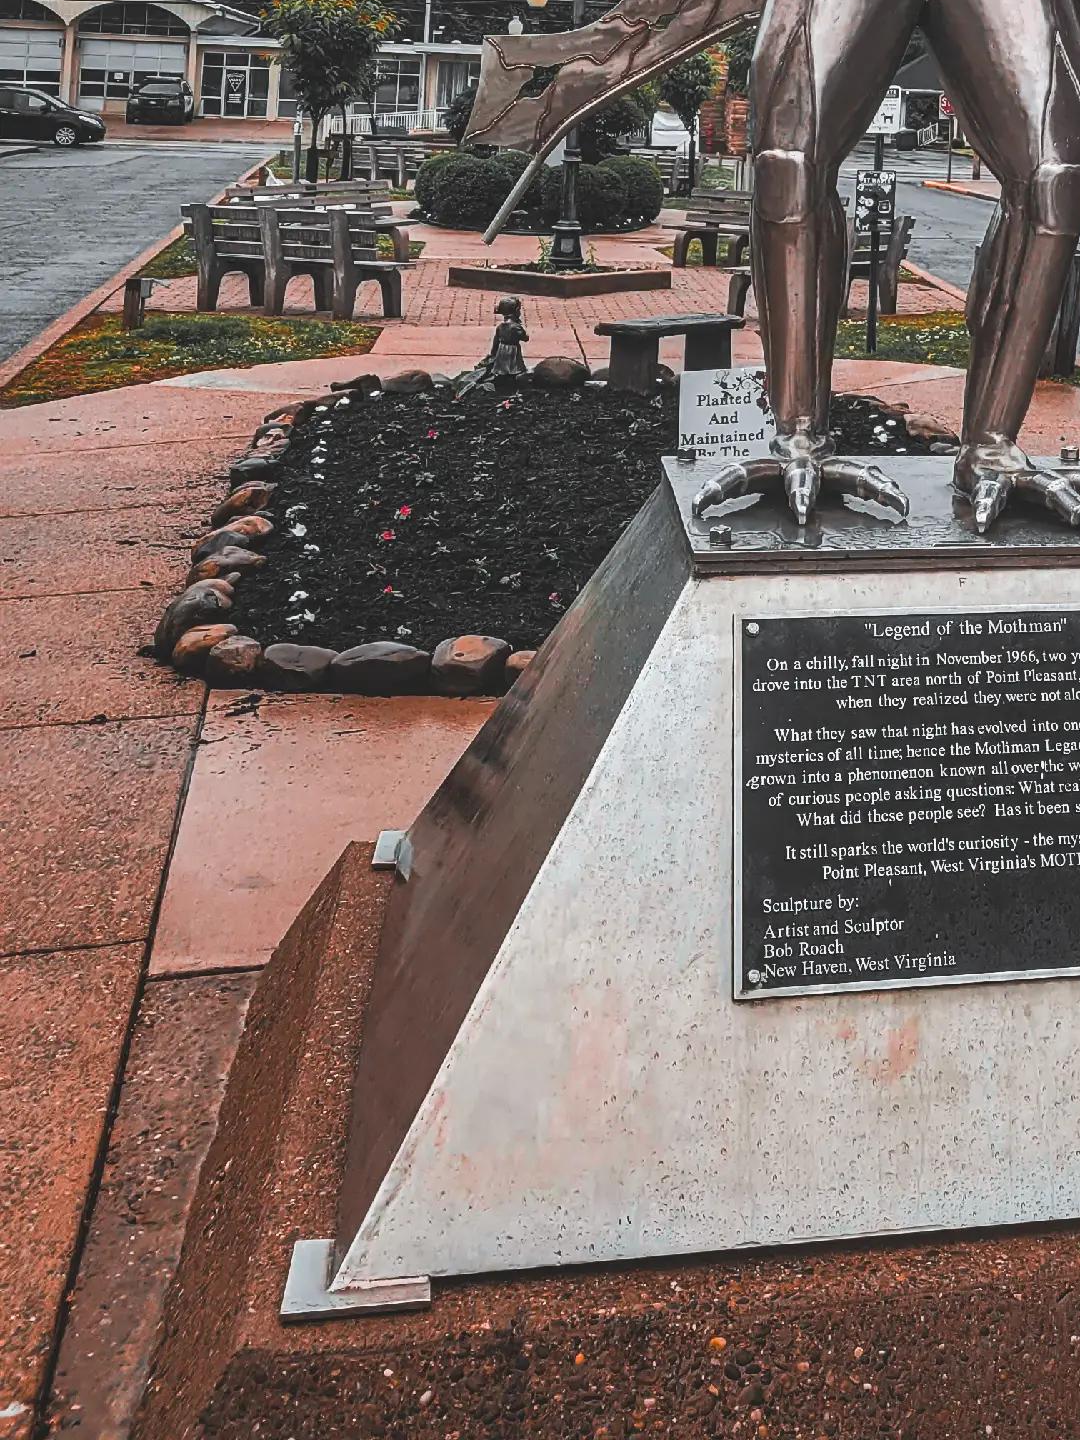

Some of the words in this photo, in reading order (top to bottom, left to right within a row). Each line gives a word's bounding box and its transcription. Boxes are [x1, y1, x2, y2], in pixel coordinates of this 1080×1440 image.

[696, 392, 751, 407] Planted
[708, 411, 738, 425] And
[681, 428, 764, 446] Maintained
[720, 446, 750, 457] The
[864, 621, 930, 641] "Legend
[936, 620, 953, 636] of
[958, 620, 983, 635] the
[988, 618, 1067, 634] Mothman"
[766, 658, 788, 671] On
[793, 660, 802, 670] a
[805, 655, 849, 672] chilly,
[851, 654, 874, 668] fall
[877, 653, 913, 670] night
[915, 653, 930, 666] in
[936, 650, 1002, 665] November
[1006, 650, 1040, 665] 1966,
[1042, 651, 1067, 662] two
[752, 678, 790, 692] drove
[793, 676, 822, 690] into
[826, 675, 848, 689] the
[850, 674, 887, 688] TNT
[891, 676, 920, 687] area
[925, 671, 962, 686] north
[967, 670, 982, 685] of
[986, 670, 1020, 684] Point
[836, 695, 873, 709] when
[878, 694, 907, 710] they
[913, 691, 969, 706] realized
[973, 690, 1001, 706] they
[1005, 692, 1037, 702] were
[1041, 689, 1061, 702] not
[773, 728, 812, 742] What
[816, 726, 846, 743] they
[851, 728, 877, 740] saw
[881, 724, 909, 738] that
[912, 723, 948, 740] night
[951, 722, 975, 736] has
[977, 719, 1027, 734] evolved
[1032, 719, 1059, 732] into
[755, 748, 824, 767] mysteries
[827, 747, 842, 762] of
[845, 746, 863, 761] all
[868, 745, 903, 761] time;
[906, 744, 946, 758] hence
[950, 742, 971, 756] the
[974, 740, 1040, 755] Mothman
[751, 774, 796, 790] grown
[802, 770, 830, 784] into
[834, 772, 842, 782] a
[847, 767, 934, 785] phenomenon
[940, 763, 986, 777] known
[991, 760, 1009, 775] all
[1011, 764, 1040, 774] over
[1044, 758, 1064, 773] the
[768, 792, 784, 807] of
[788, 790, 841, 806] curious
[845, 787, 891, 807] people
[894, 785, 942, 802] asking
[946, 782, 1015, 802] questions:
[1018, 780, 1055, 794] What
[796, 811, 836, 826] What
[839, 809, 862, 825] did
[867, 808, 904, 823] these
[908, 805, 953, 825] people
[957, 803, 986, 819] see?
[995, 803, 1022, 817] Has
[1024, 801, 1035, 815] it
[1038, 801, 1070, 815] been
[786, 846, 796, 860] It
[799, 844, 828, 860] still
[830, 842, 878, 861] sparks
[881, 841, 903, 855] the
[906, 838, 955, 853] world's
[958, 835, 1019, 852] curiosity
[1032, 833, 1054, 847] the
[823, 864, 860, 880] Point
[865, 862, 927, 876] Pleasant,
[931, 859, 964, 873] West
[968, 854, 1037, 874] Virginia's
[763, 897, 833, 915] Sculpture
[838, 894, 859, 912] by:
[763, 923, 810, 940] Artist
[813, 921, 839, 935] and
[844, 918, 905, 936] Sculptor
[764, 943, 793, 959] Bob
[799, 940, 845, 957] Roach
[764, 963, 797, 979] New
[802, 961, 853, 976] Haven,
[856, 957, 890, 972] West
[895, 951, 957, 972] Virginia
